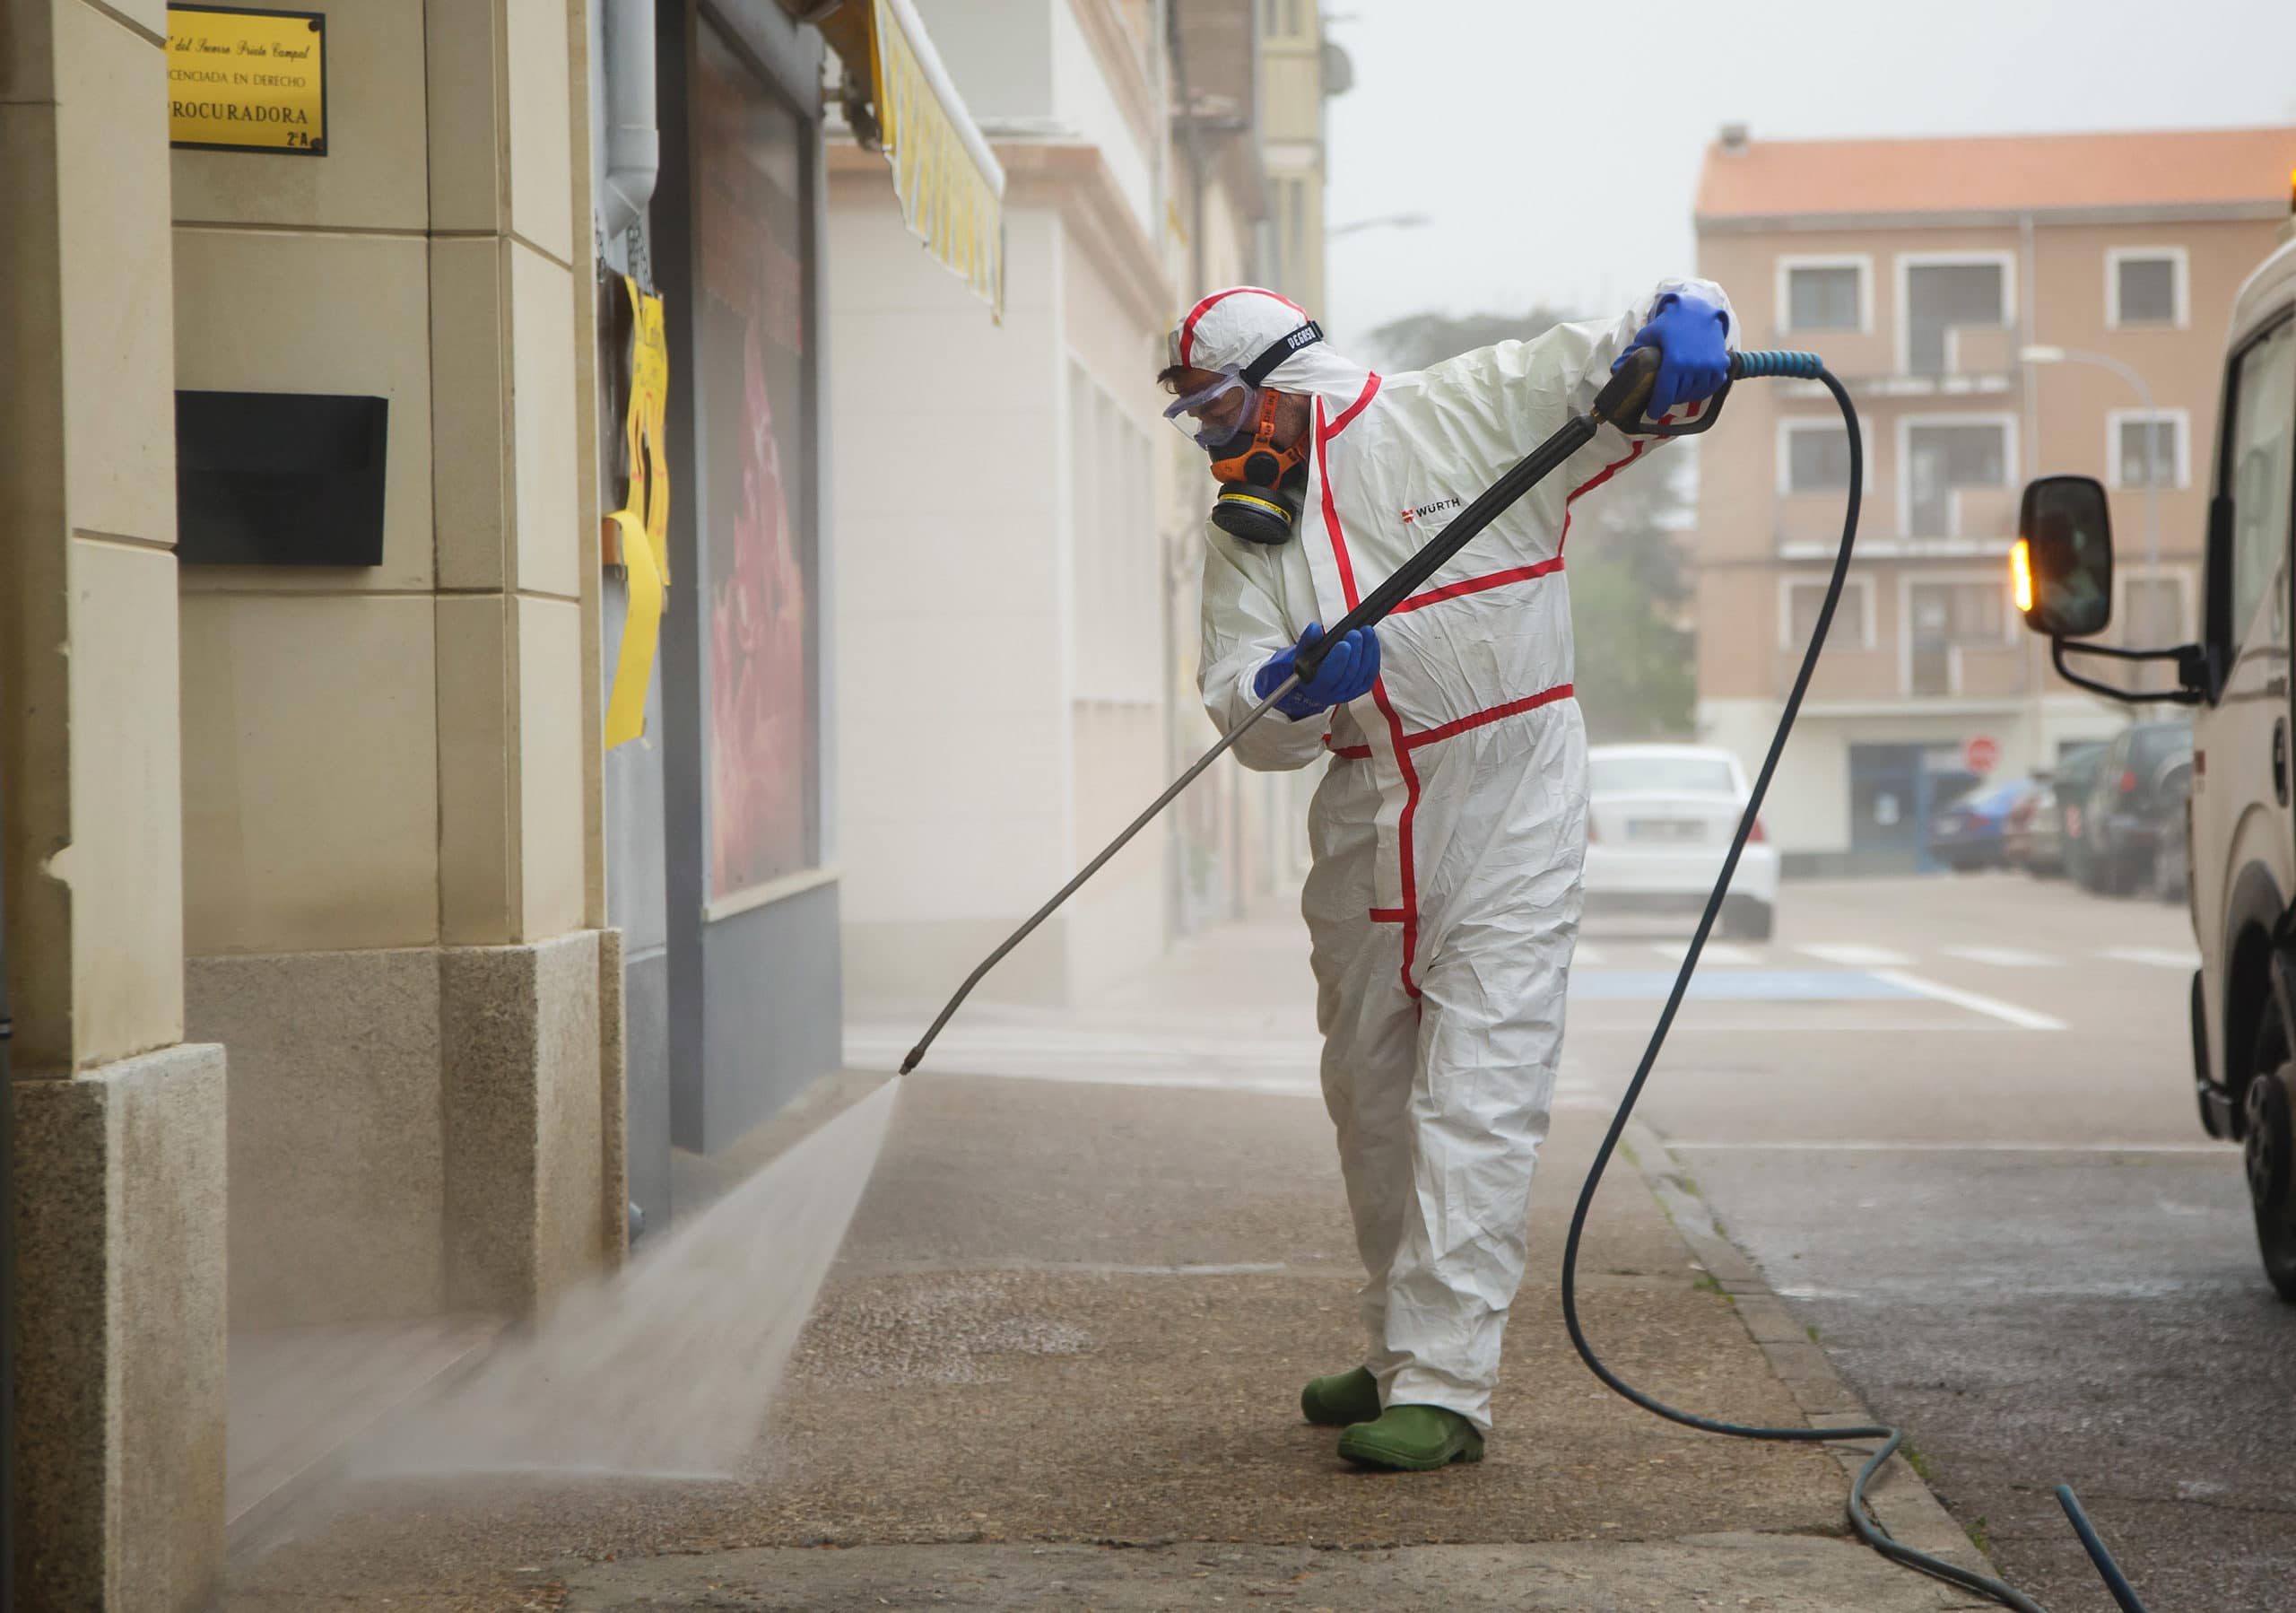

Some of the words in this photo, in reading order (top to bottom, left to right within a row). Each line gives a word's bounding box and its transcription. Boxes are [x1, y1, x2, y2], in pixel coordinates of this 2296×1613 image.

[175, 39, 193, 52] del
[272, 43, 310, 63] Campal
[168, 70, 229, 84] ICENCIADA
[233, 72, 249, 85] EN
[253, 74, 306, 89] DERECHO
[169, 100, 309, 125] ROCURADORA
[1416, 497, 1461, 518] WÜRTH
